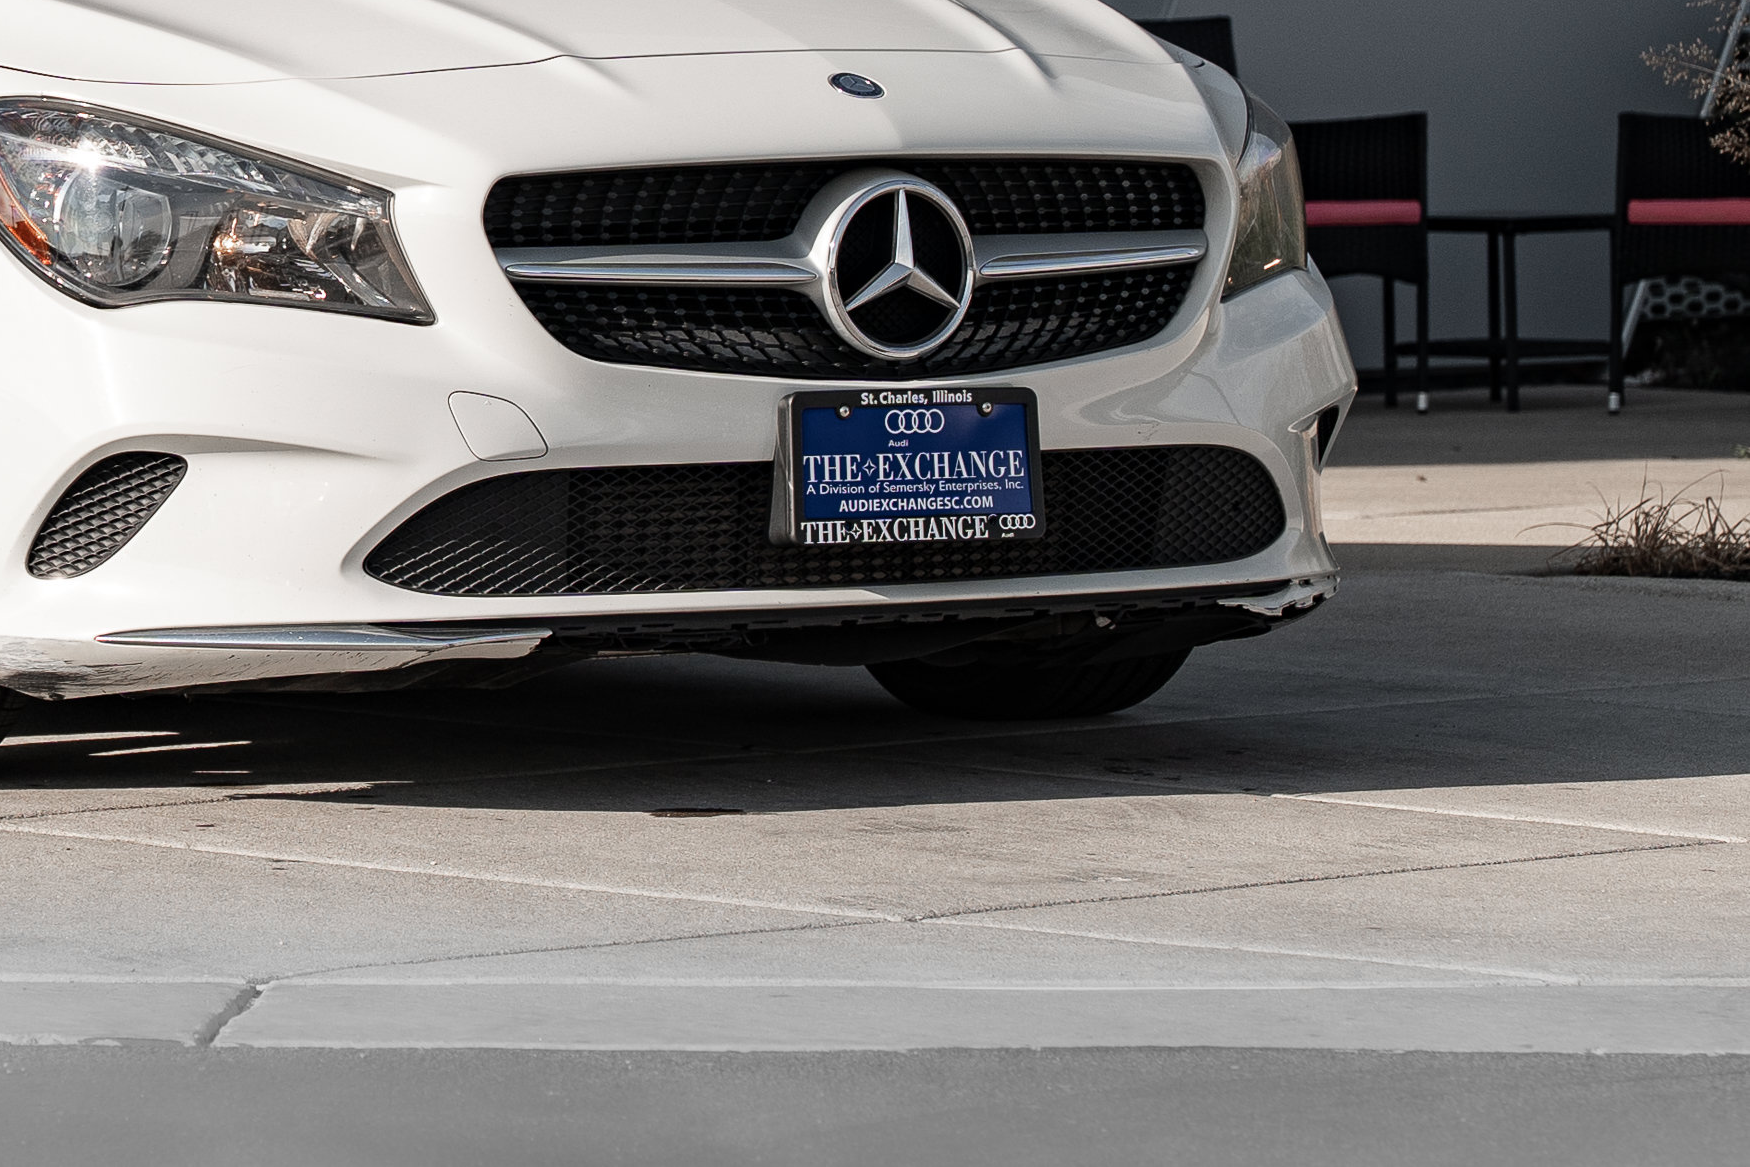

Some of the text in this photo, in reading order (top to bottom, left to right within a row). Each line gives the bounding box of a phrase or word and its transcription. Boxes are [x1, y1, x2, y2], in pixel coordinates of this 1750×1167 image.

[860, 390, 972, 405] St. Charles, Illinois
[888, 439, 909, 447] Audi
[803, 450, 1024, 482] THE EXCHANGE
[806, 478, 1024, 495] A Division of Semersky Enterprises, Inc.
[839, 495, 994, 512] AUDIEXCHANGESC.COM
[800, 515, 989, 544] THE EXCHANGE
